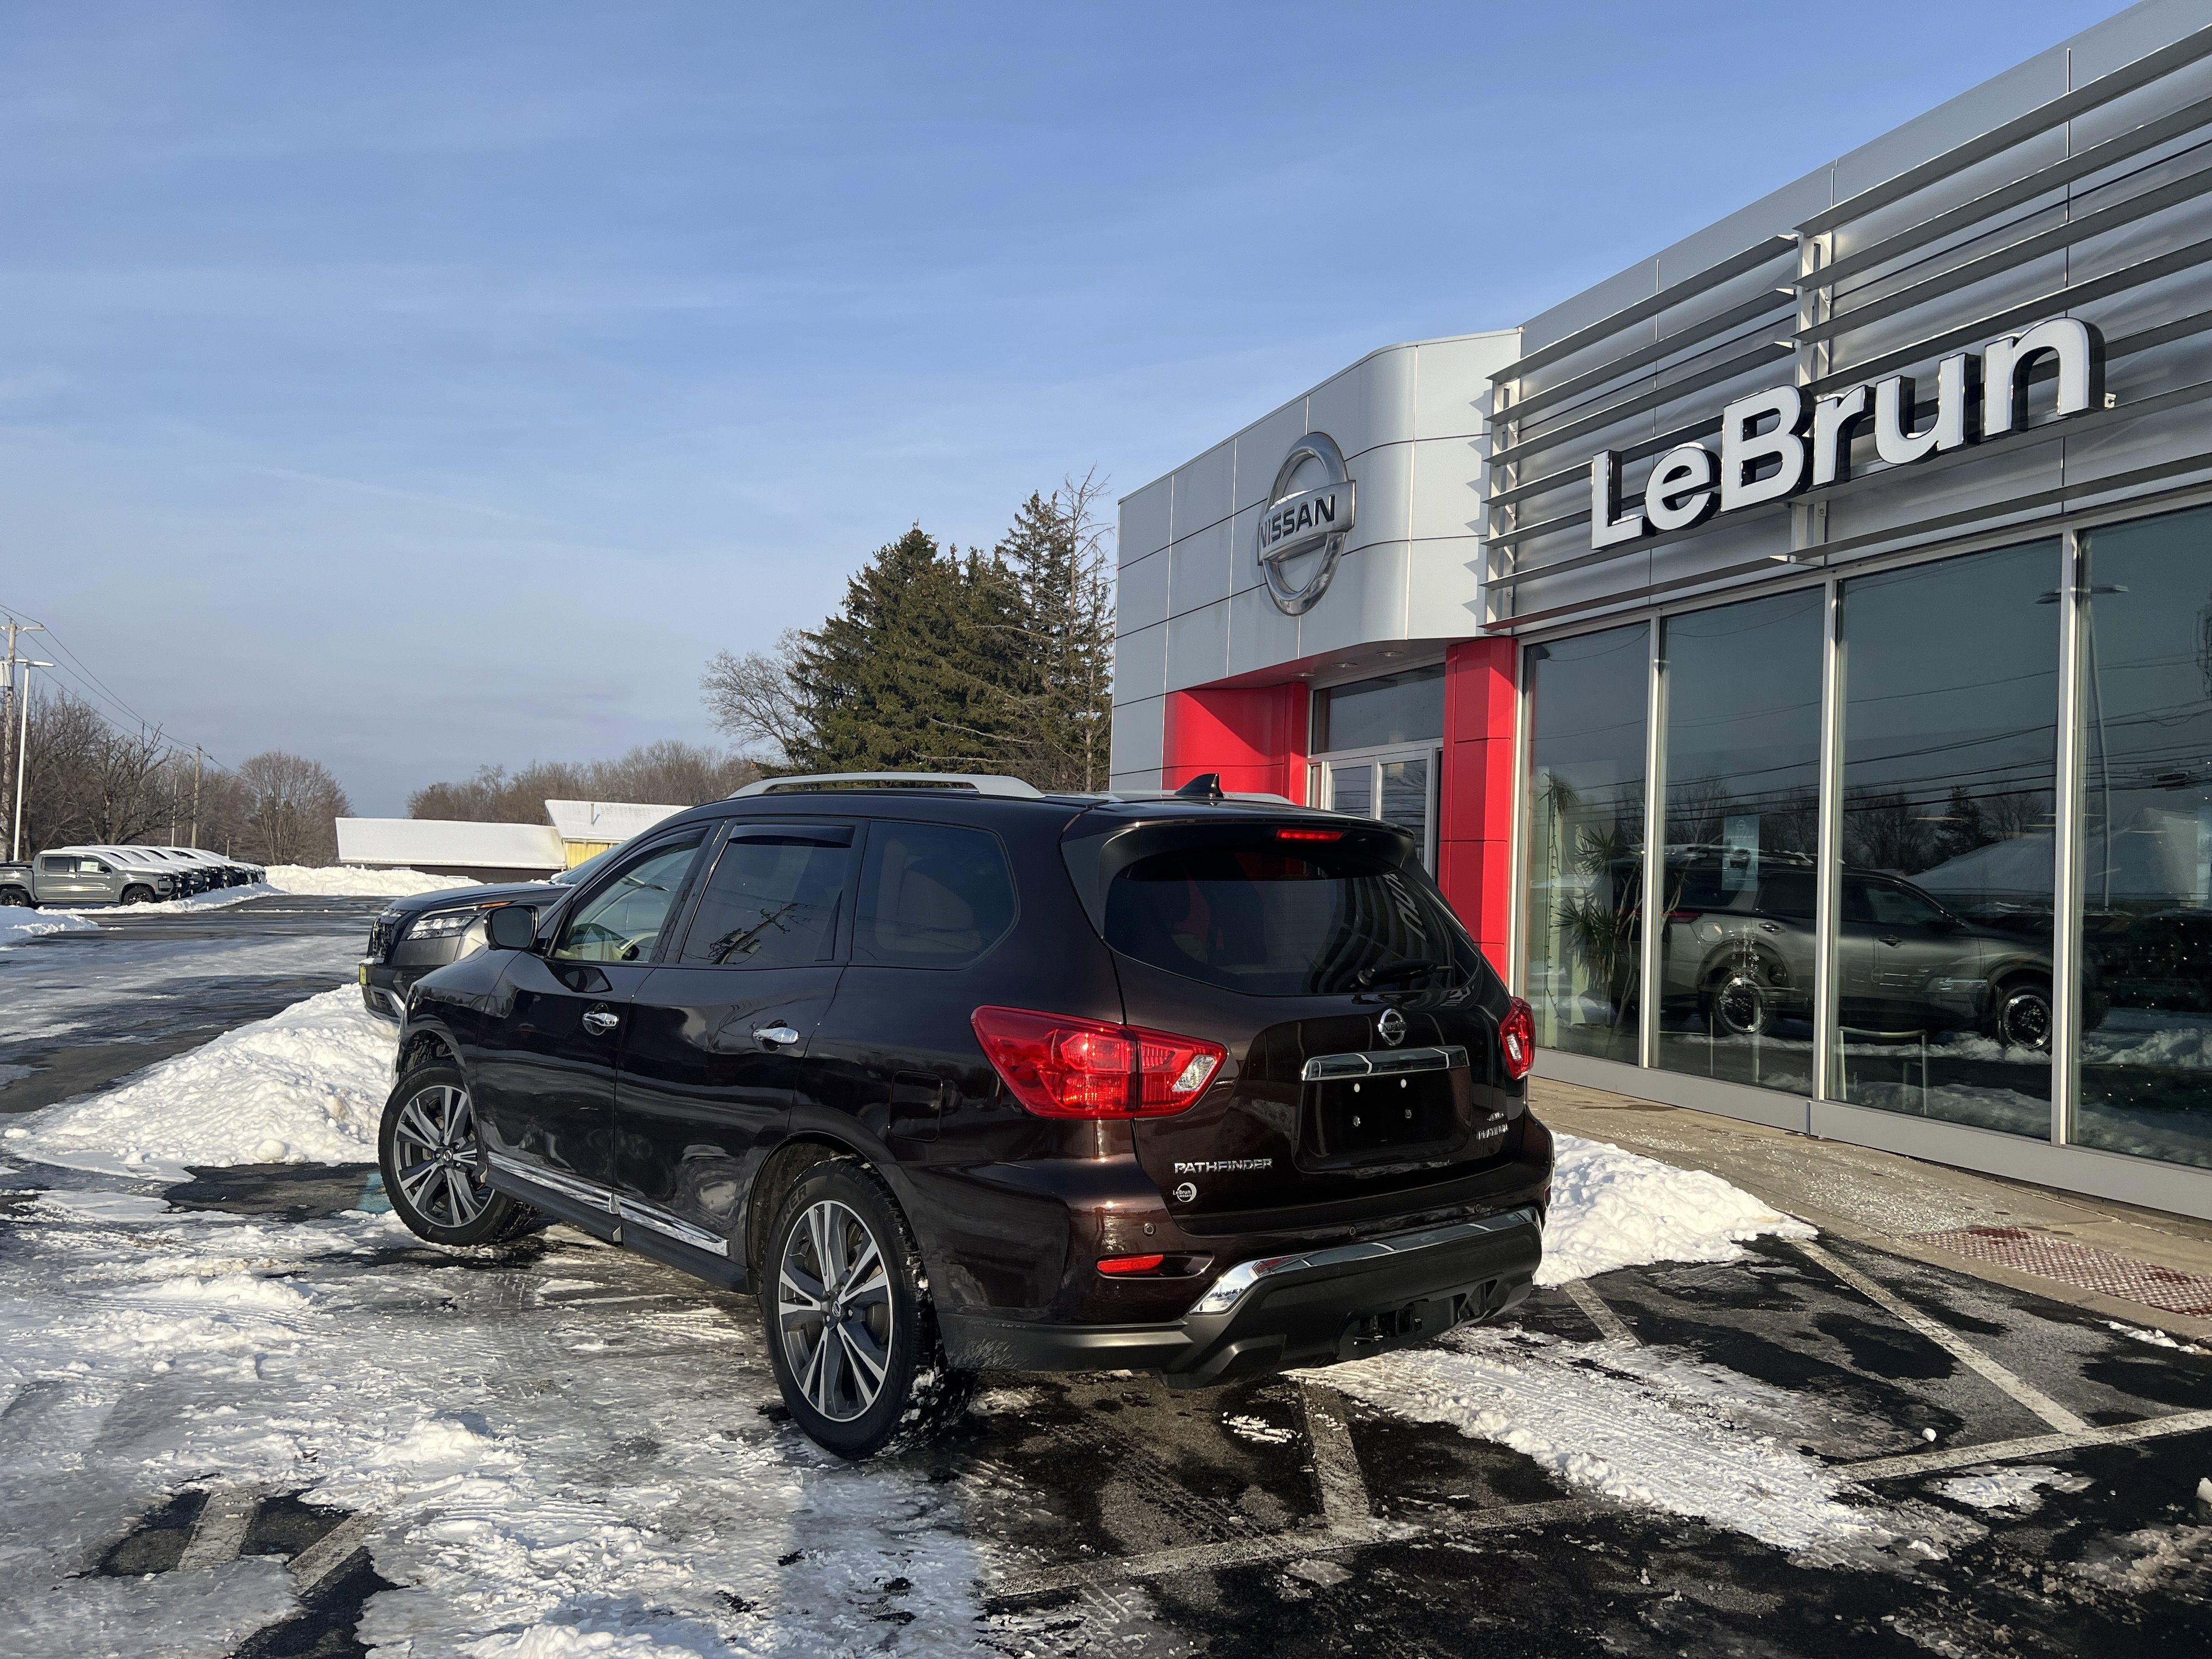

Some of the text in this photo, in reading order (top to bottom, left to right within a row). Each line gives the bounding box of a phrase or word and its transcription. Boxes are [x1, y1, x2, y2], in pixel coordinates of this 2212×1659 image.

[1592, 317, 2103, 549] LeBrun
[1261, 494, 1335, 548] NISSAN
[1174, 1158, 1273, 1174] PATHFINDER
